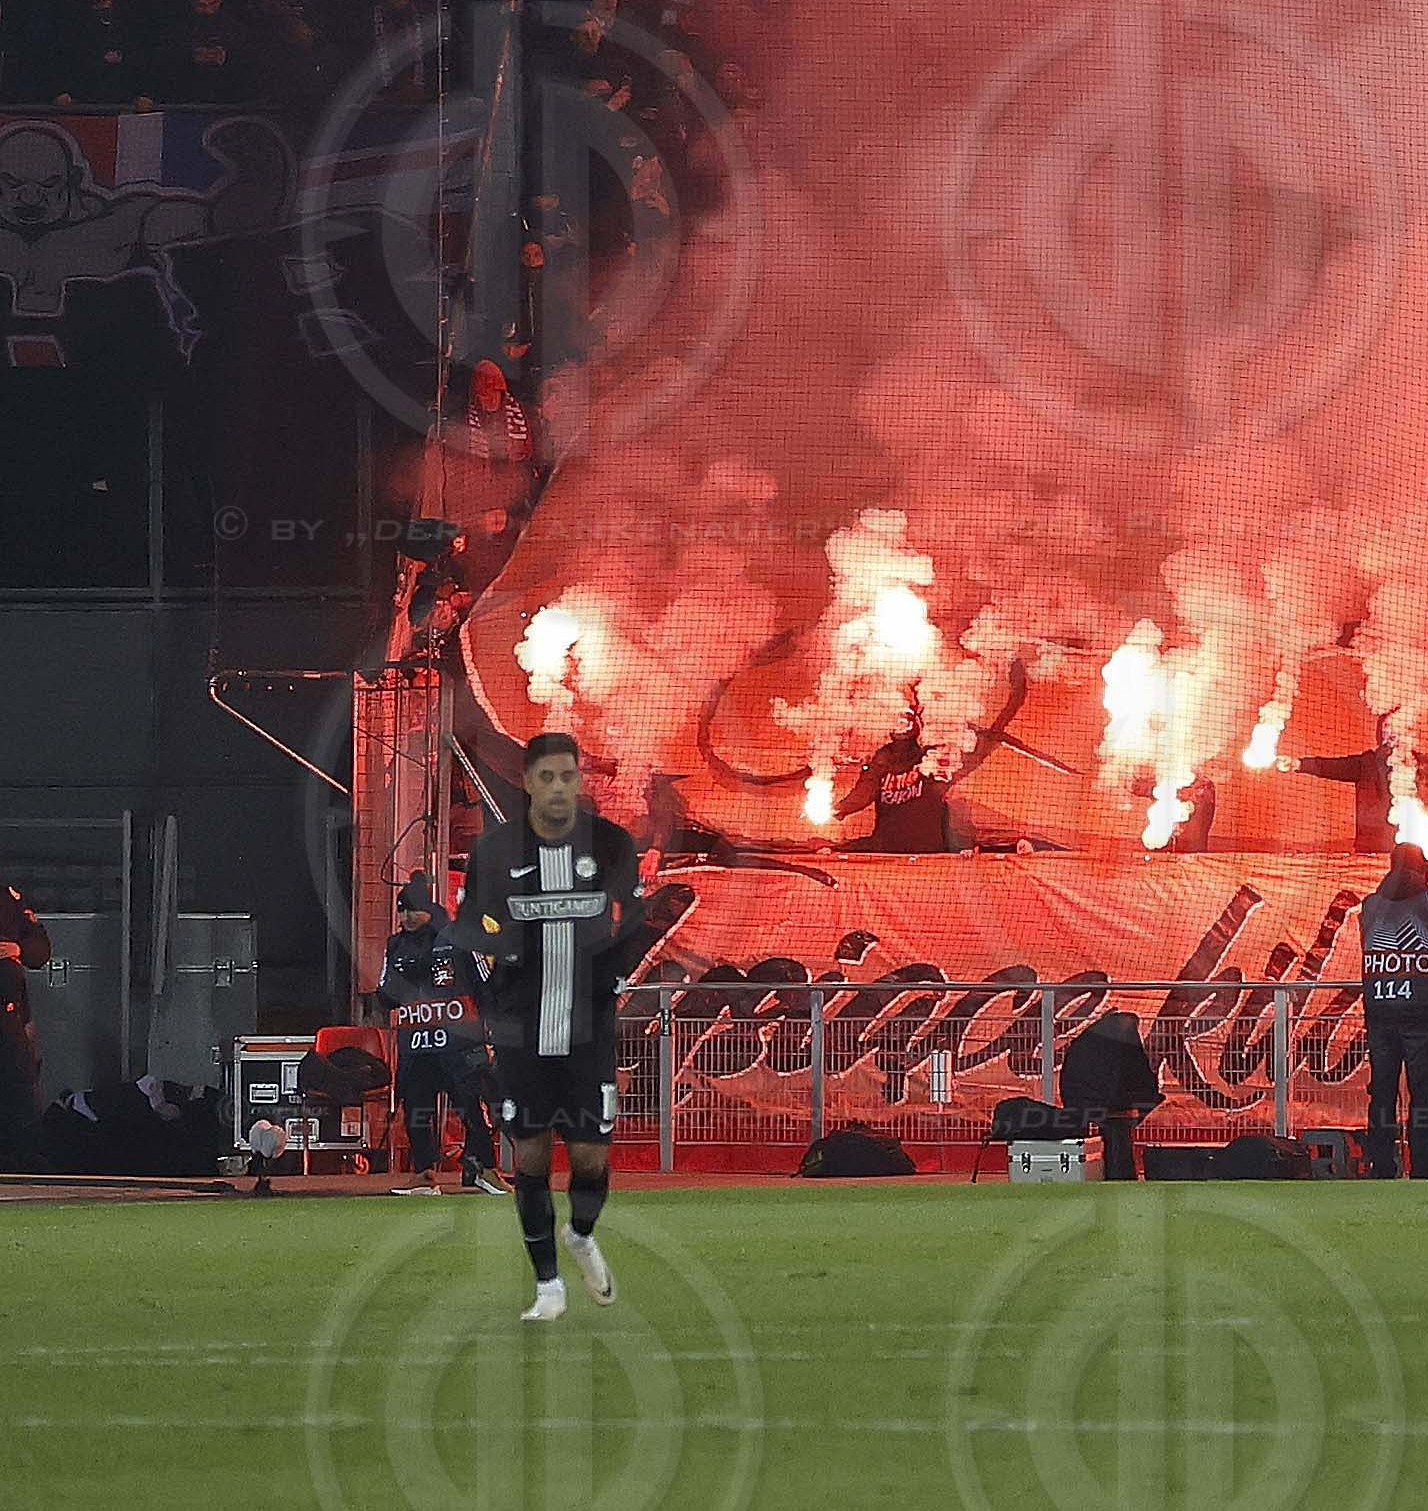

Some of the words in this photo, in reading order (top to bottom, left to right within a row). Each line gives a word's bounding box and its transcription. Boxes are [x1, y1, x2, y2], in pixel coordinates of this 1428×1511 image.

[1372, 979, 1413, 1000] 114
[398, 1000, 464, 1026] PHOTO
[410, 1028, 448, 1051] 019
